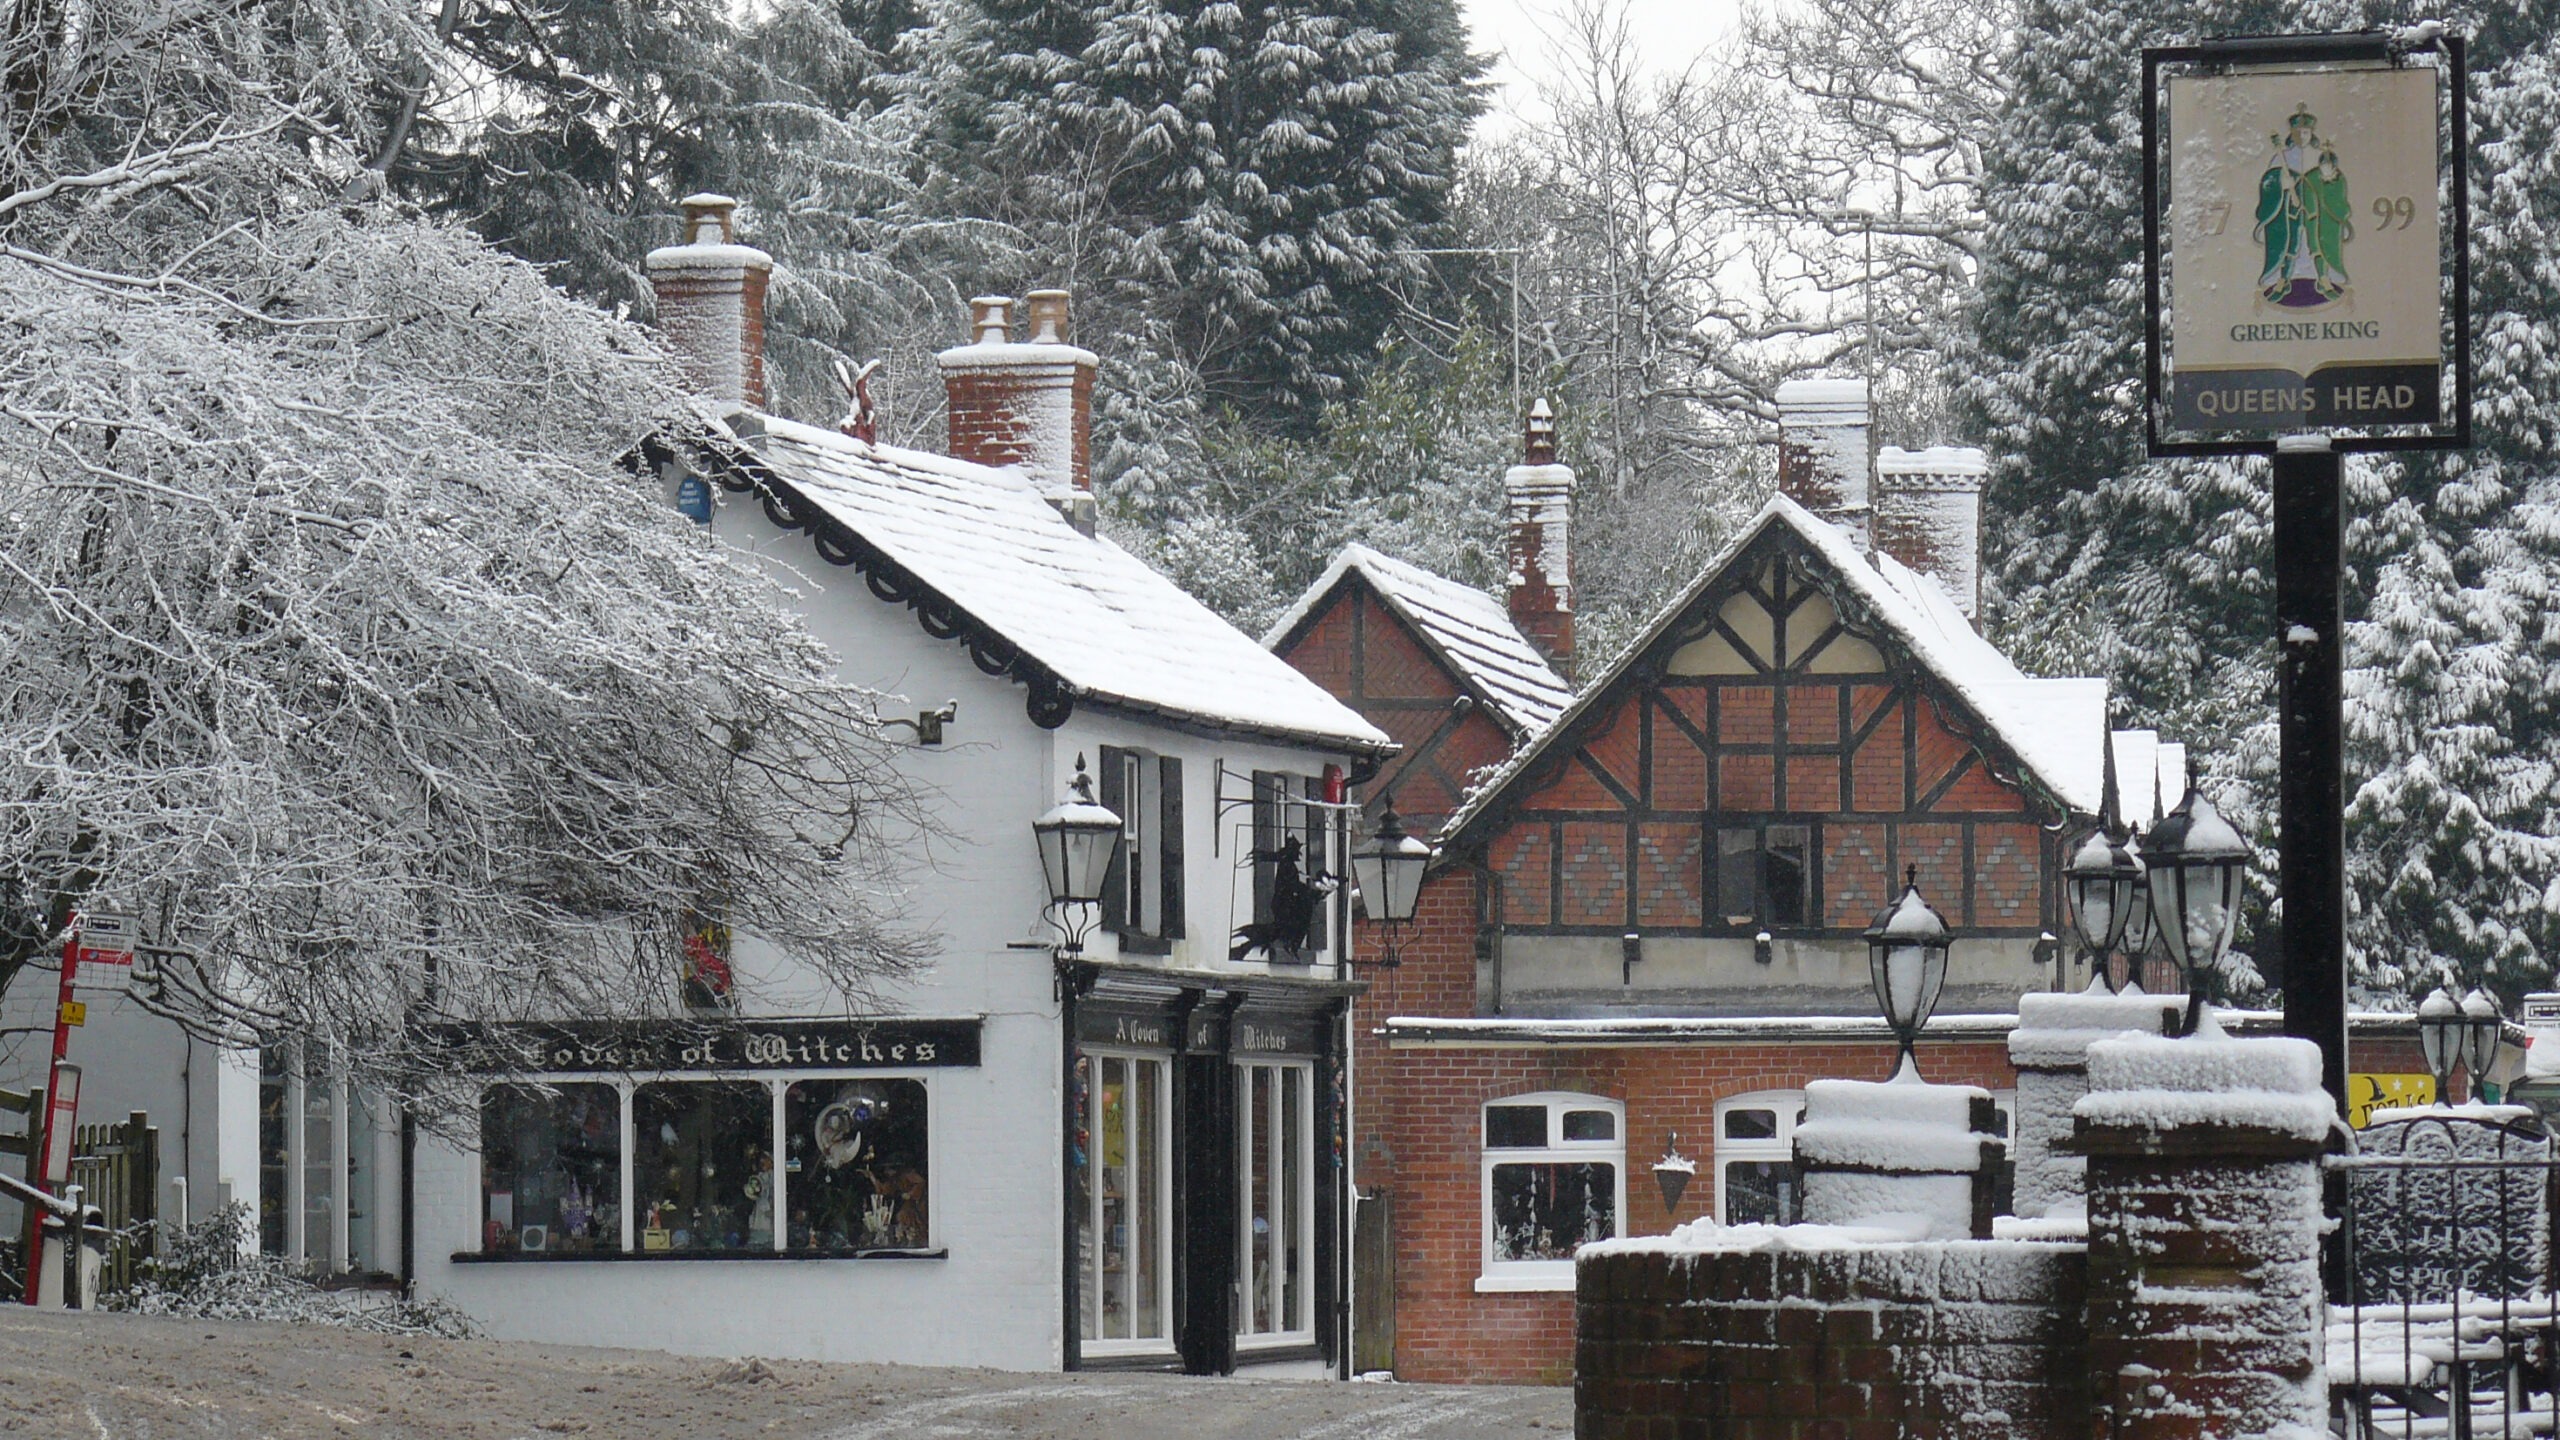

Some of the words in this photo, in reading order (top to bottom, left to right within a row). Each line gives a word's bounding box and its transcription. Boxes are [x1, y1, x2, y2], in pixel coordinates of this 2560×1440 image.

[2372, 196, 2415, 231] 99
[2230, 322, 2317, 342] GREENE
[2322, 320, 2380, 340] KING
[2197, 387, 2316, 417] QUEENS
[2333, 385, 2416, 411] HEAD
[682, 1035, 720, 1064] of
[745, 1032, 936, 1065] Witches
[1116, 1017, 1126, 1041] A
[1130, 1019, 1159, 1044] Coven
[1197, 1023, 1208, 1046] of
[1243, 1024, 1287, 1051] Witches
[2388, 1265, 2483, 1288] SPICE
